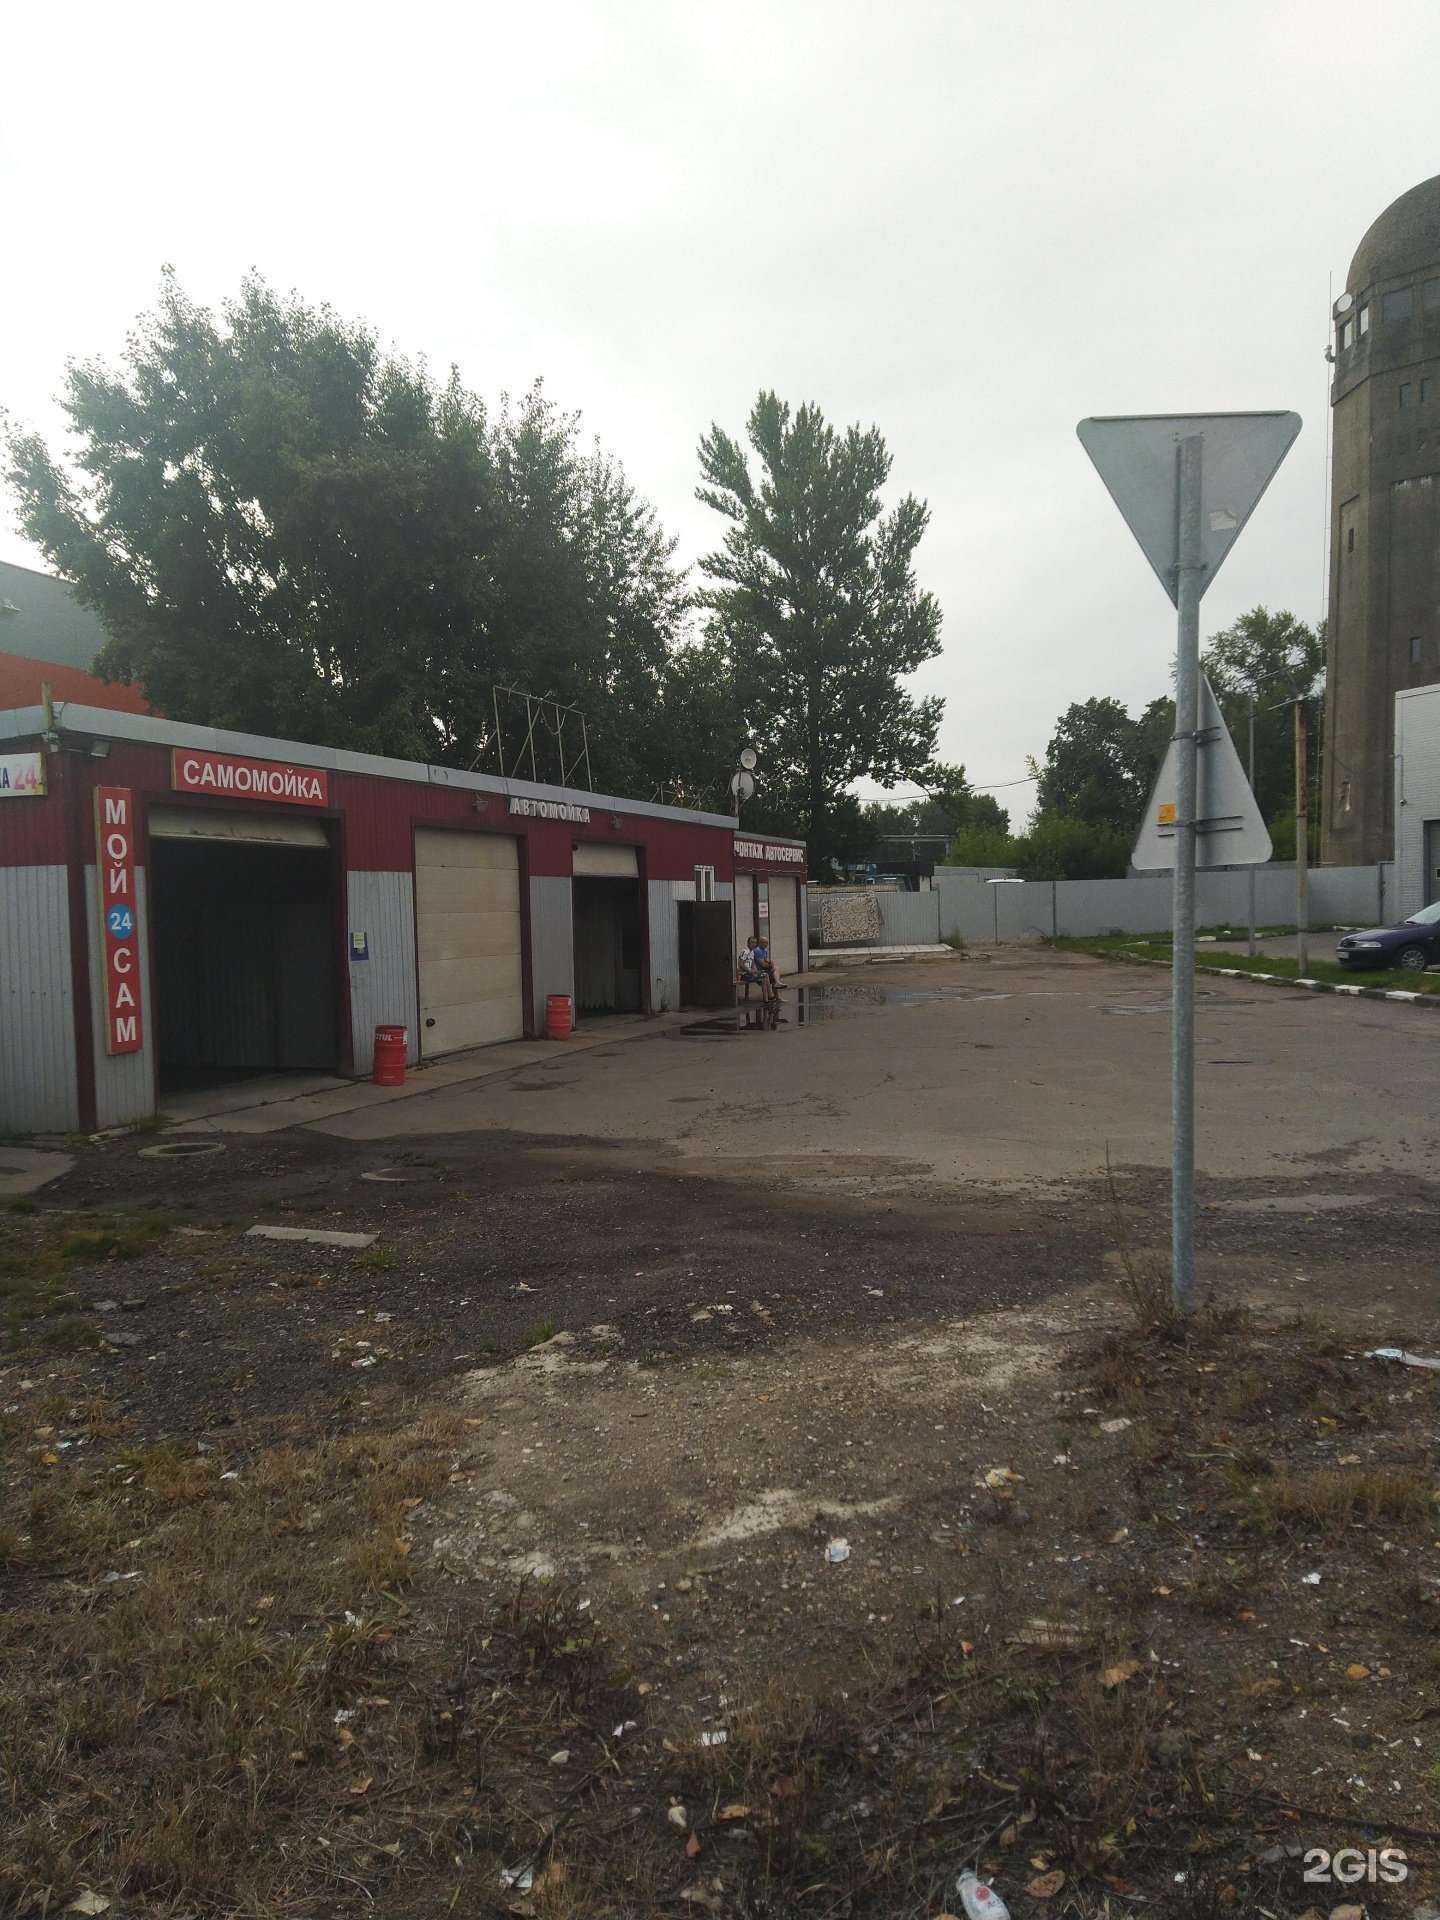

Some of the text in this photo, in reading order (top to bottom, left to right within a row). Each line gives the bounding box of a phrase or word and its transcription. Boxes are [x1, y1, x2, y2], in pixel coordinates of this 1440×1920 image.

[0, 767, 10, 789] А
[183, 759, 323, 800] САМОМОЙКА
[509, 797, 591, 823] АВТОМОЙКА
[105, 798, 128, 894] МОЙ
[765, 845, 804, 863] АВТОСЕРВИС
[110, 912, 132, 931] 24
[113, 947, 137, 1043] САМ
